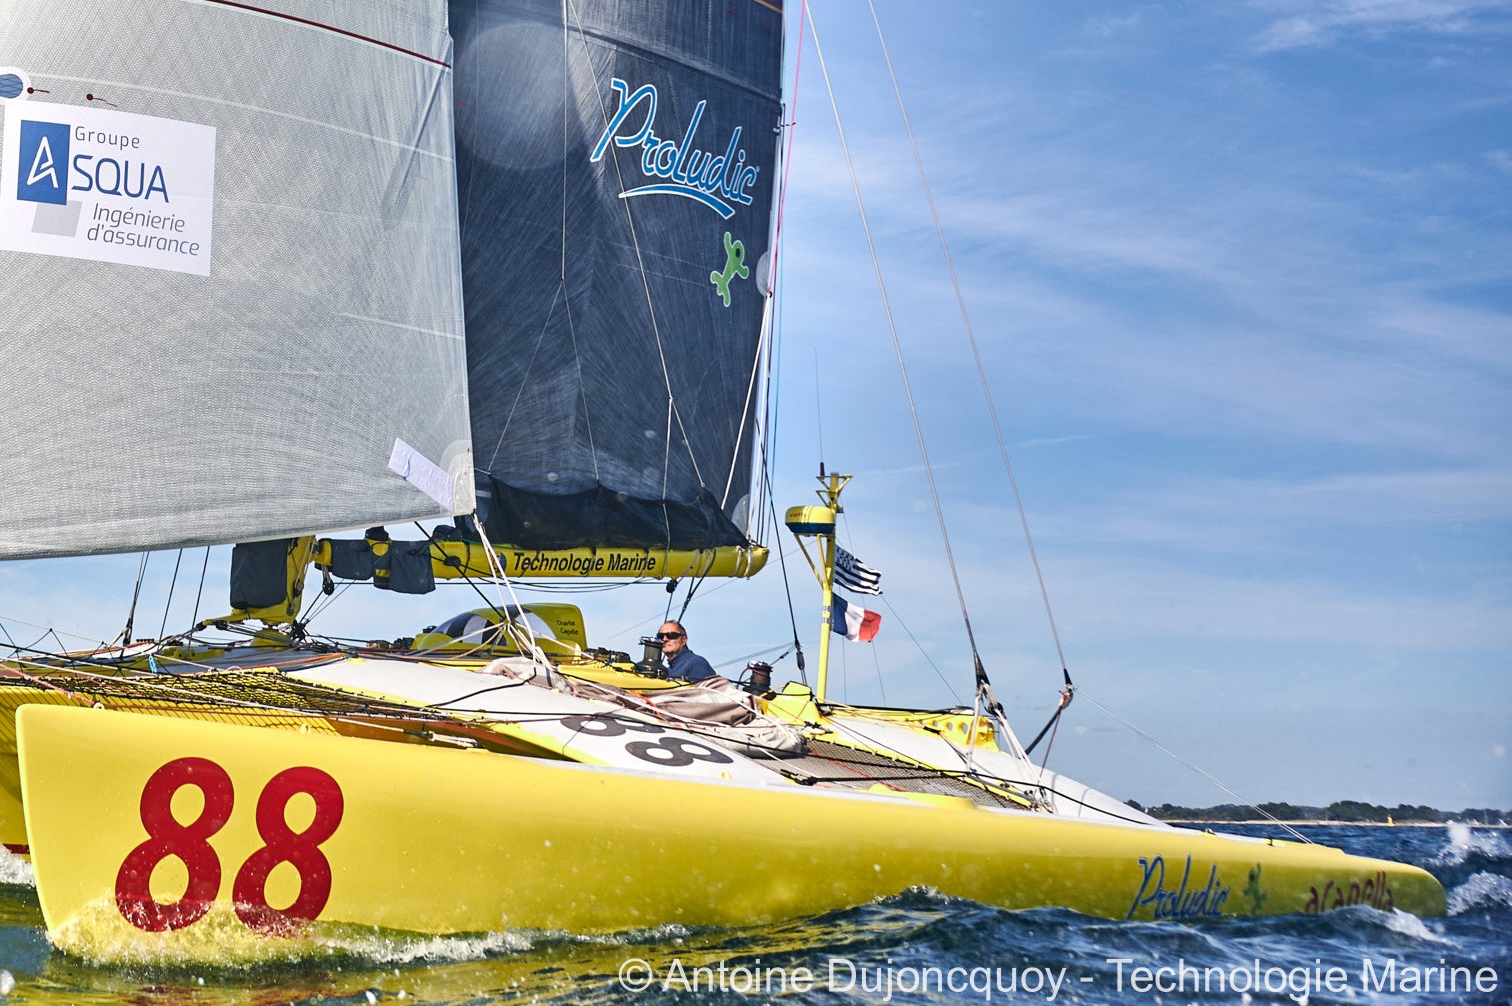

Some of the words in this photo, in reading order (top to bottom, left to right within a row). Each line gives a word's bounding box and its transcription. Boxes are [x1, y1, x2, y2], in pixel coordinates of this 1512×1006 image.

[75, 125, 140, 150] Groupe
[93, 203, 185, 232] Ingénierie
[87, 224, 200, 256] d'assurance
[514, 552, 604, 575] Technologie
[607, 554, 656, 572] Marine
[115, 756, 344, 938] 88
